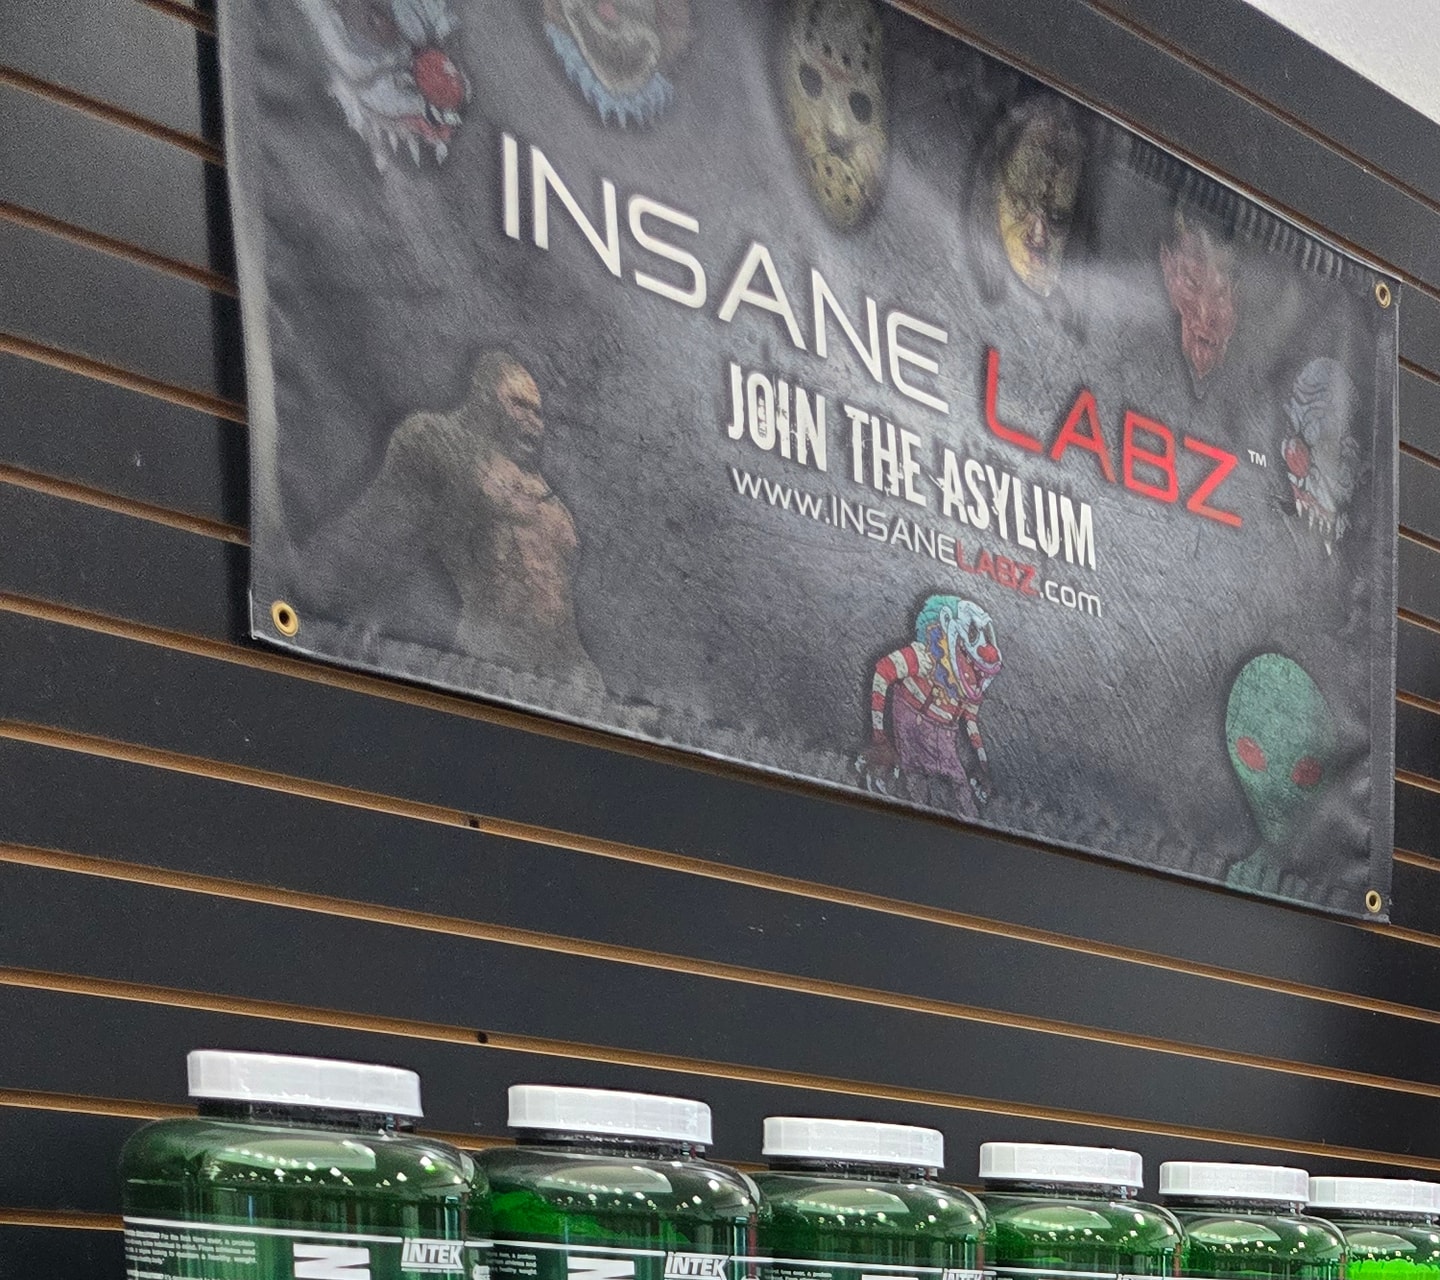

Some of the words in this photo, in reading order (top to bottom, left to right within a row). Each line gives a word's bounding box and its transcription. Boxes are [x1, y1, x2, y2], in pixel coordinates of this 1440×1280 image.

[502, 133, 949, 414] INSANE
[984, 349, 1244, 527] LABZ
[726, 362, 828, 473] JOIN
[844, 403, 922, 498] THE
[941, 448, 1096, 570] ASYLUM
[401, 1238, 464, 1269] INTEK
[664, 1252, 728, 1280] INTEK
